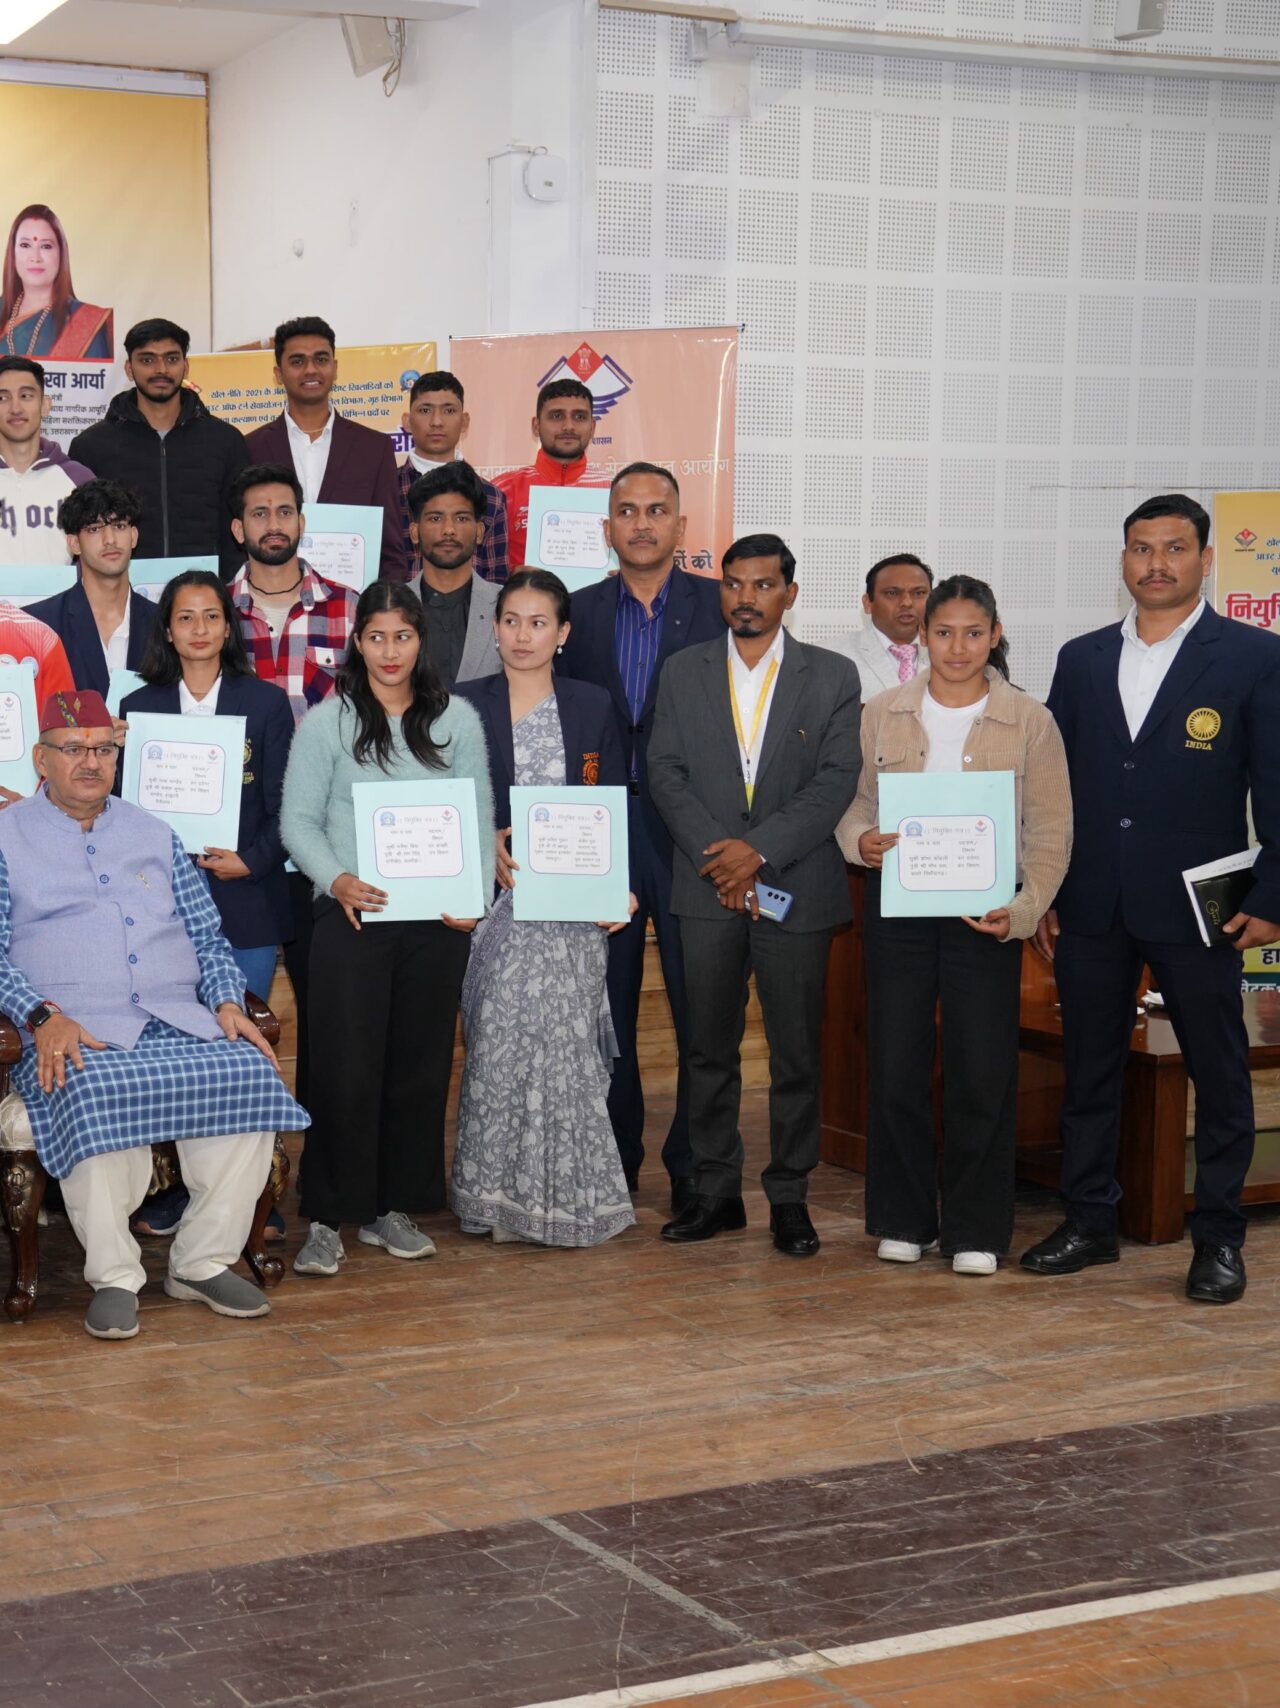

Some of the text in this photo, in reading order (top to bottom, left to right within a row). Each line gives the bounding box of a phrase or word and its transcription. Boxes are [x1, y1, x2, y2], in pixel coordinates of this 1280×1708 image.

[71, 369, 106, 389] आर्या
[246, 389, 262, 397] 2021
[591, 436, 613, 445] शासन
[680, 457, 730, 476] आयोग
[691, 550, 712, 569] को
[1184, 739, 1213, 751] INDIA
